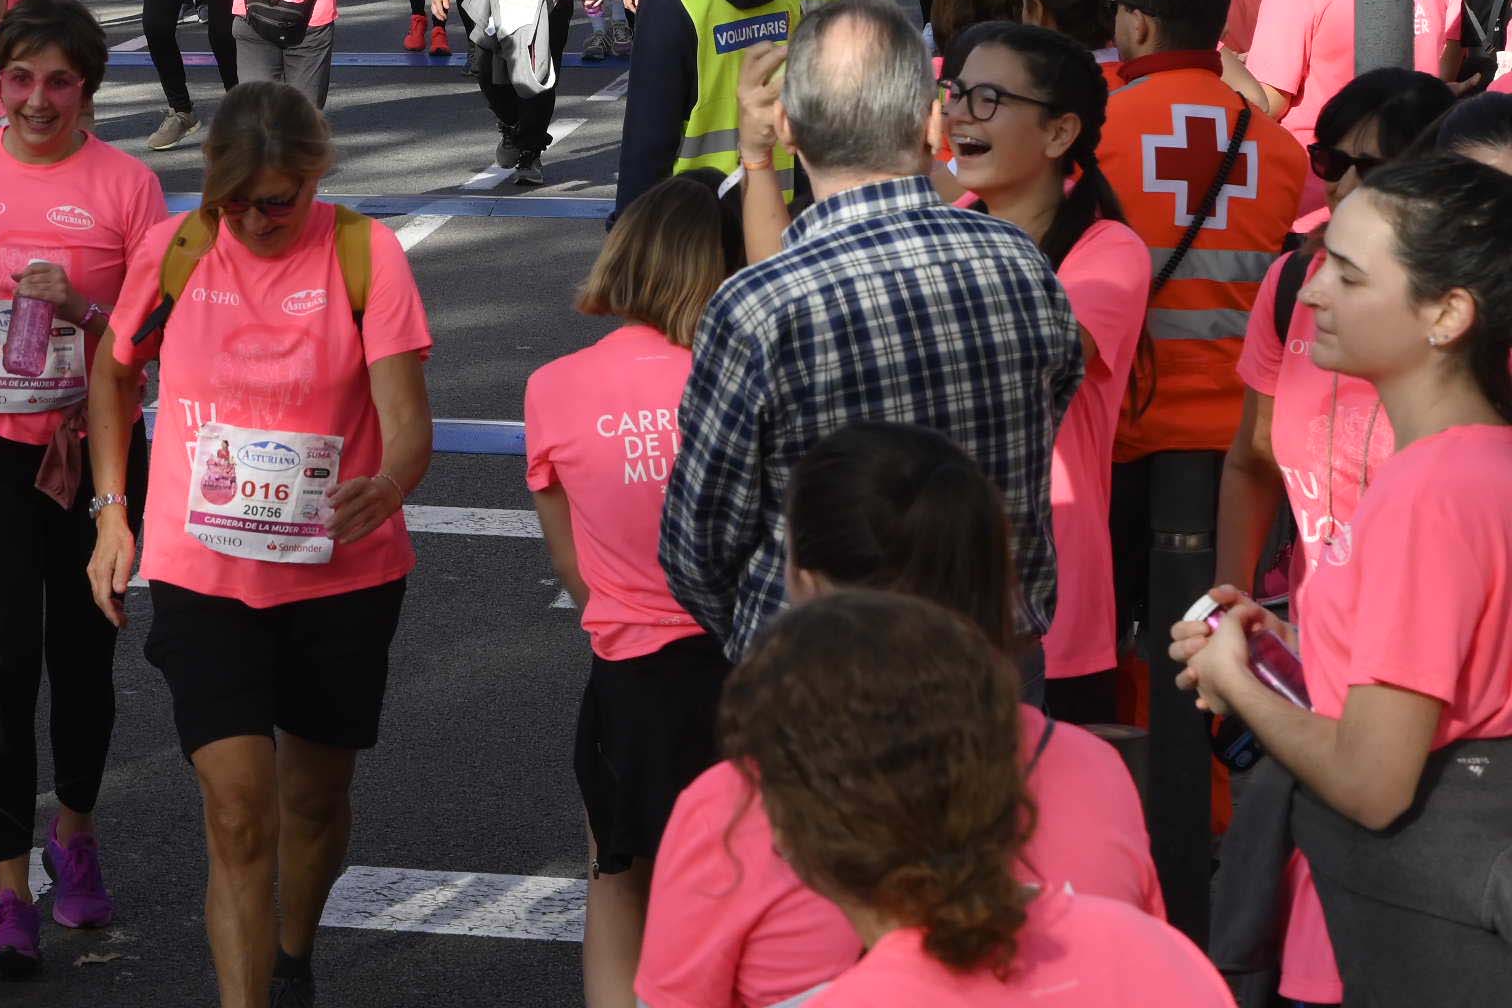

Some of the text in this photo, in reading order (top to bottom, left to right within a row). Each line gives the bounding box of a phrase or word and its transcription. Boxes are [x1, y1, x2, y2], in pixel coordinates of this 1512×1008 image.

[716, 19, 787, 46] VOLUNTARIS
[50, 211, 93, 226] ASTURIANA
[191, 288, 240, 306] OYSHO
[597, 408, 679, 437] CARR
[306, 451, 331, 459] SUMA
[624, 433, 661, 460] DE
[241, 450, 296, 465] ASTURIANA
[241, 480, 290, 501] 016
[1279, 465, 1319, 500] TU
[243, 504, 282, 518] 20756
[204, 516, 244, 529] CARRERA
[245, 521, 256, 529] DE
[258, 523, 270, 531] LA
[271, 524, 300, 533] MUJER
[198, 533, 243, 547] OYSHO
[278, 543, 322, 553] Santander
